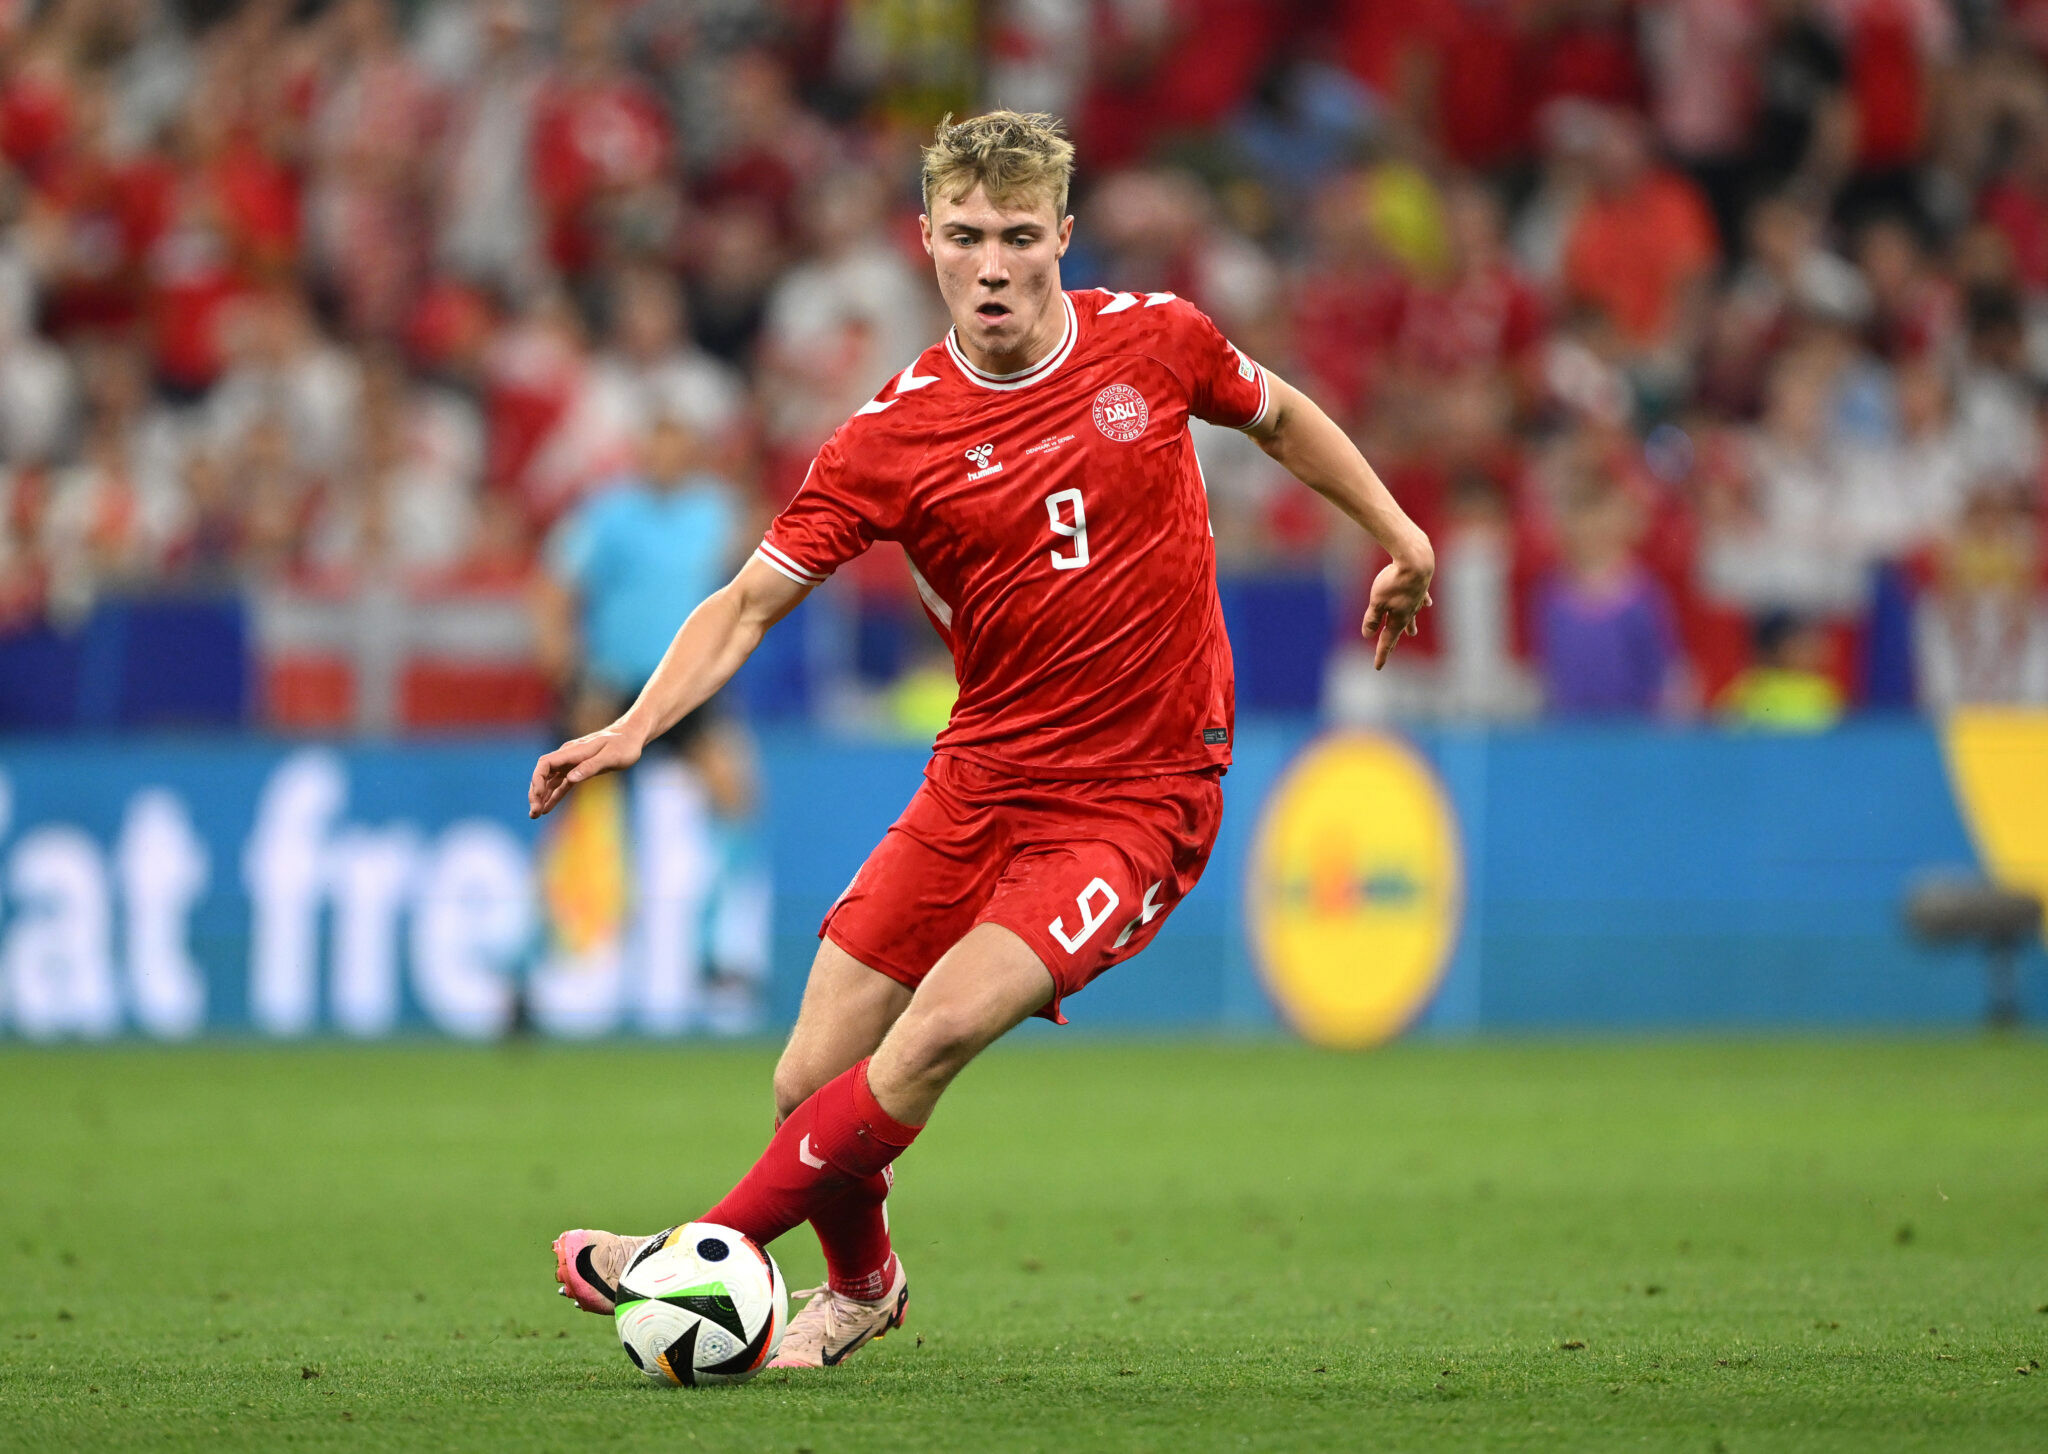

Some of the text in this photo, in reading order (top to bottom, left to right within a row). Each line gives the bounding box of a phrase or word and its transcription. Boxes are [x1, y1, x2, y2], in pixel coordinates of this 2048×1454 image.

[1095, 406, 1114, 437] DANSK
[1104, 402, 1138, 423] DBU
[1136, 398, 1147, 428] UNION
[1118, 429, 1139, 440] 1889
[967, 461, 1003, 481] hummel
[1045, 488, 1090, 570] 9
[0, 768, 208, 1040] at
[1048, 877, 1119, 955] 9
